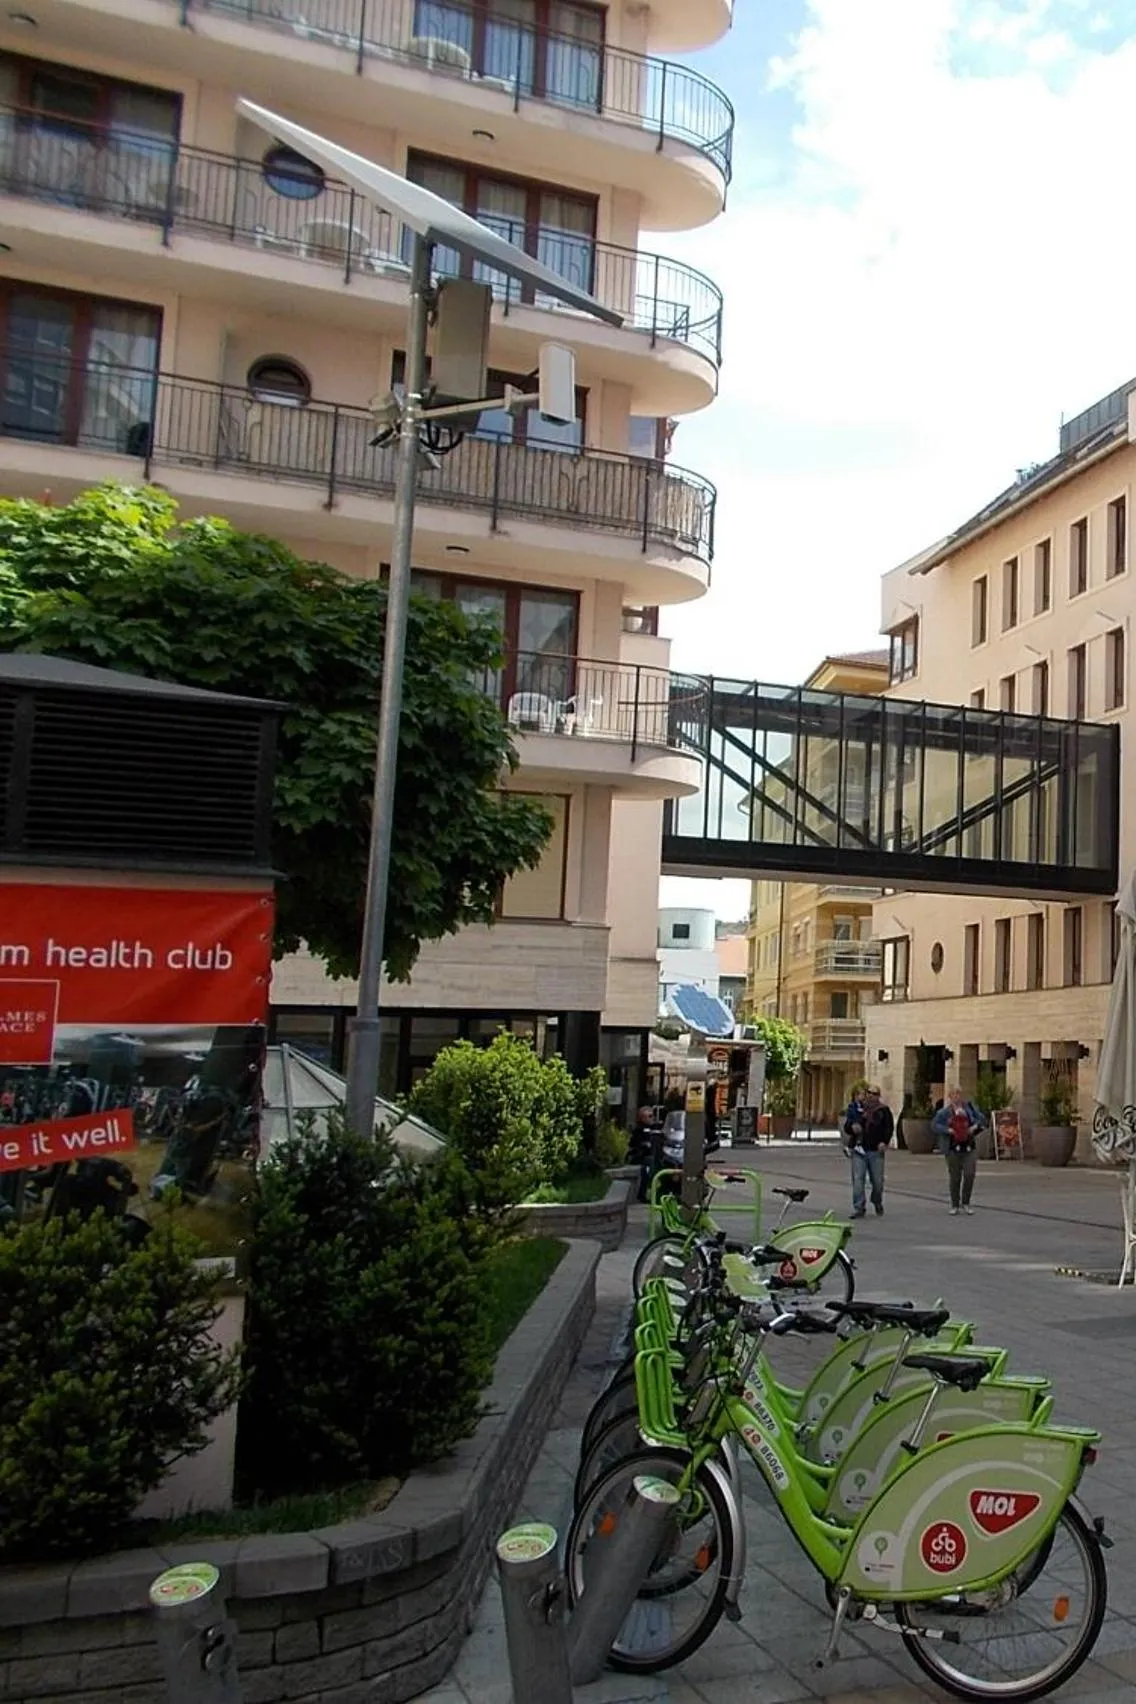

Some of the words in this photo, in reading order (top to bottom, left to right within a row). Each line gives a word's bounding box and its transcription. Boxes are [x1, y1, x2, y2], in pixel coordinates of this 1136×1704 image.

[46, 938, 153, 969] health
[167, 941, 233, 971] club
[0, 1010, 48, 1022] MES
[31, 1131, 53, 1156] it
[61, 1118, 127, 1150] well.
[976, 1495, 1016, 1516] MOL
[929, 1552, 957, 1566] bubi
